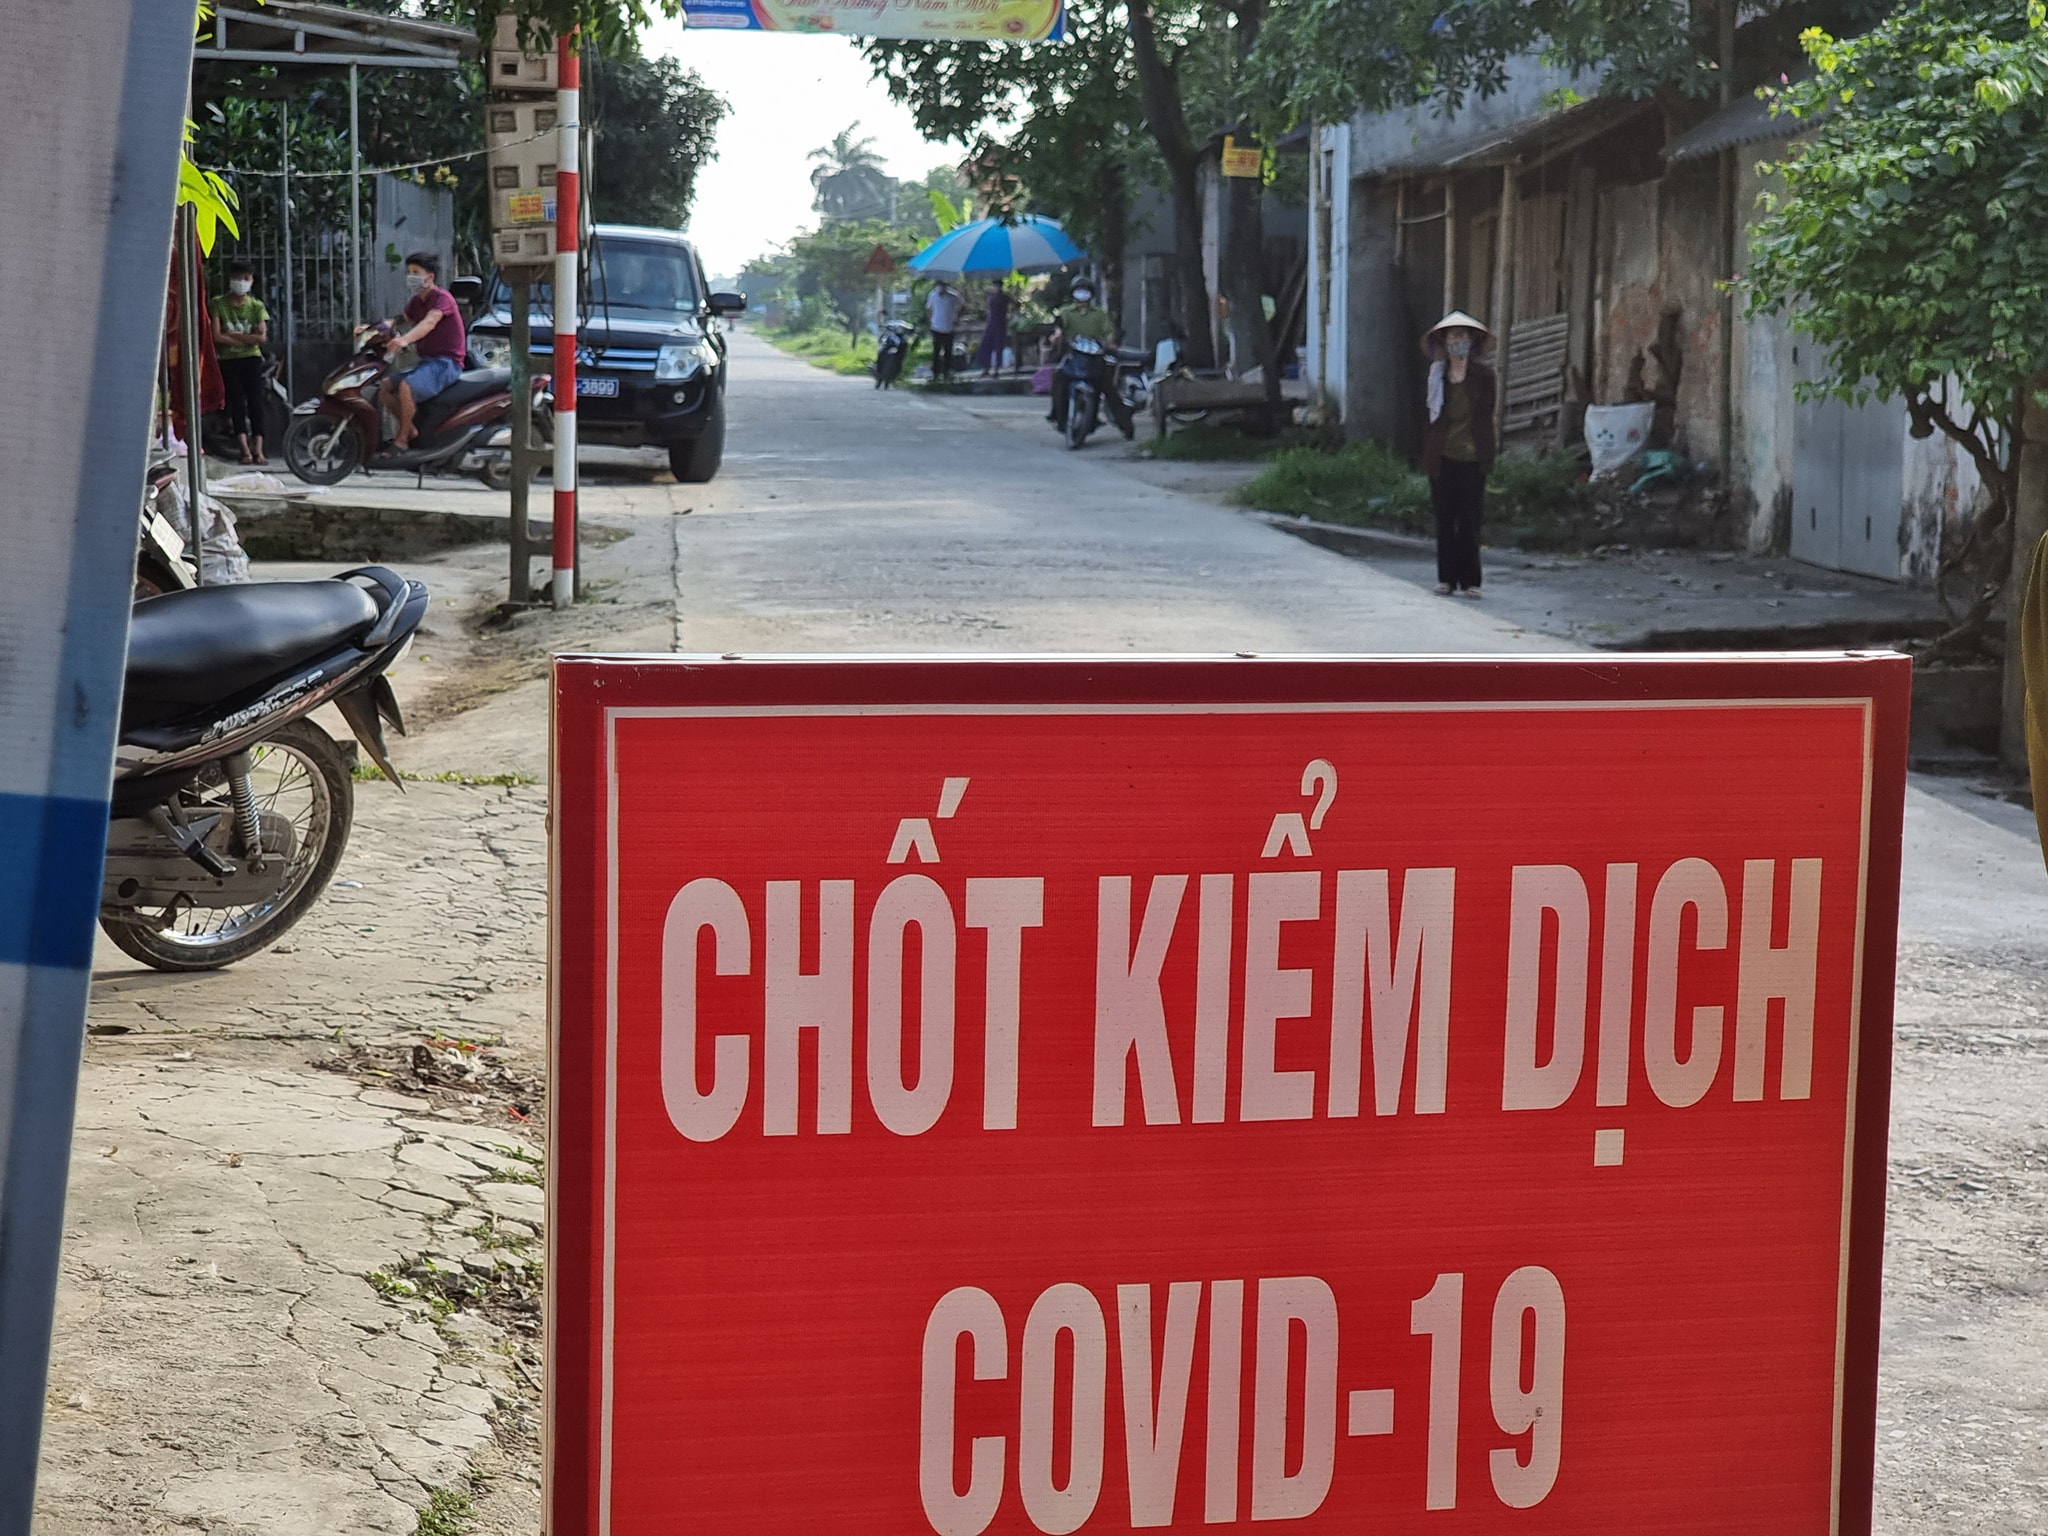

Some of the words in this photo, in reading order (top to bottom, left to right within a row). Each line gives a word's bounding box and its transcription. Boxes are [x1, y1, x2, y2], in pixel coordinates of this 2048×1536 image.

[660, 777, 1046, 1144] CHỐT
[1090, 758, 1457, 1129] KIỂM
[1501, 856, 1824, 1168] DỊCH
[918, 1264, 1567, 1536] COVID-19
